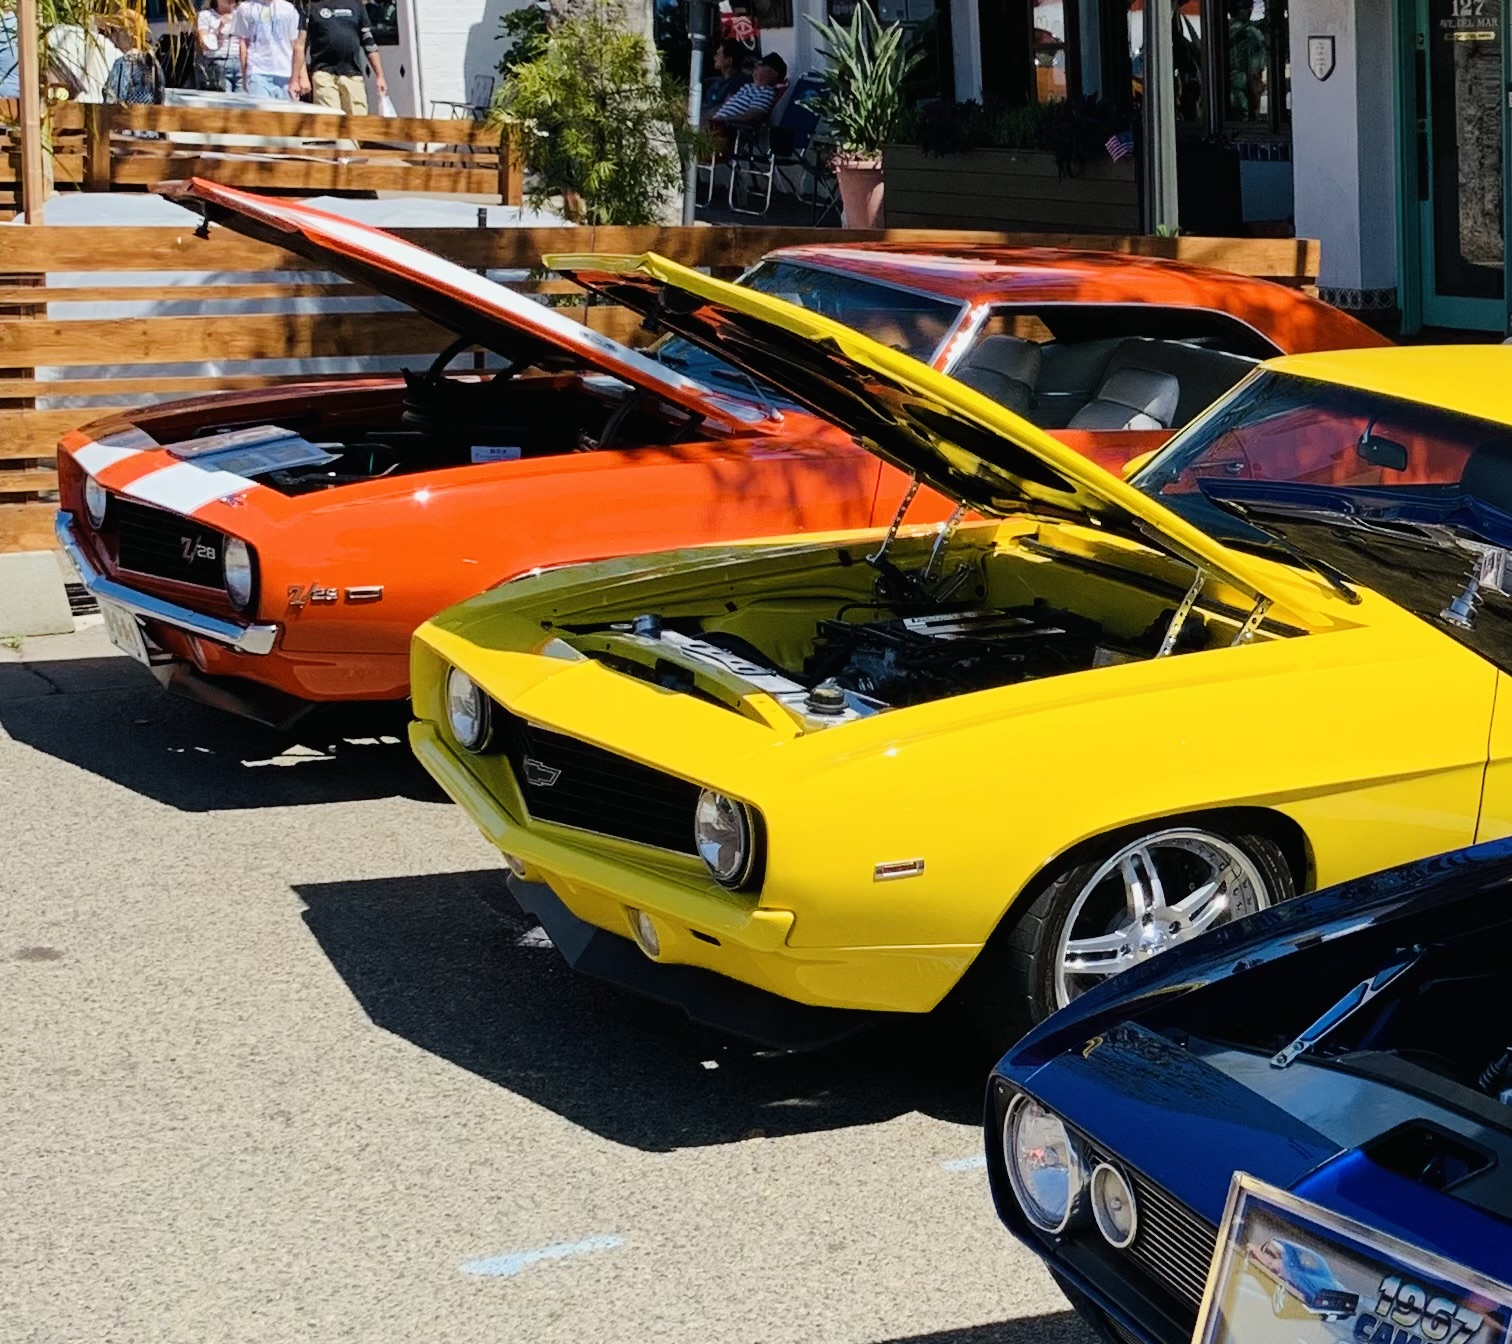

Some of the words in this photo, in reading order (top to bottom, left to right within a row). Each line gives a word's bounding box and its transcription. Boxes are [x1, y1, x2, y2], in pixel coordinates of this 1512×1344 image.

[1457, 18, 1474, 28] DEL
[1477, 17, 1499, 27] MAR
[180, 534, 217, 565] Z/28
[287, 580, 340, 609] Z/28
